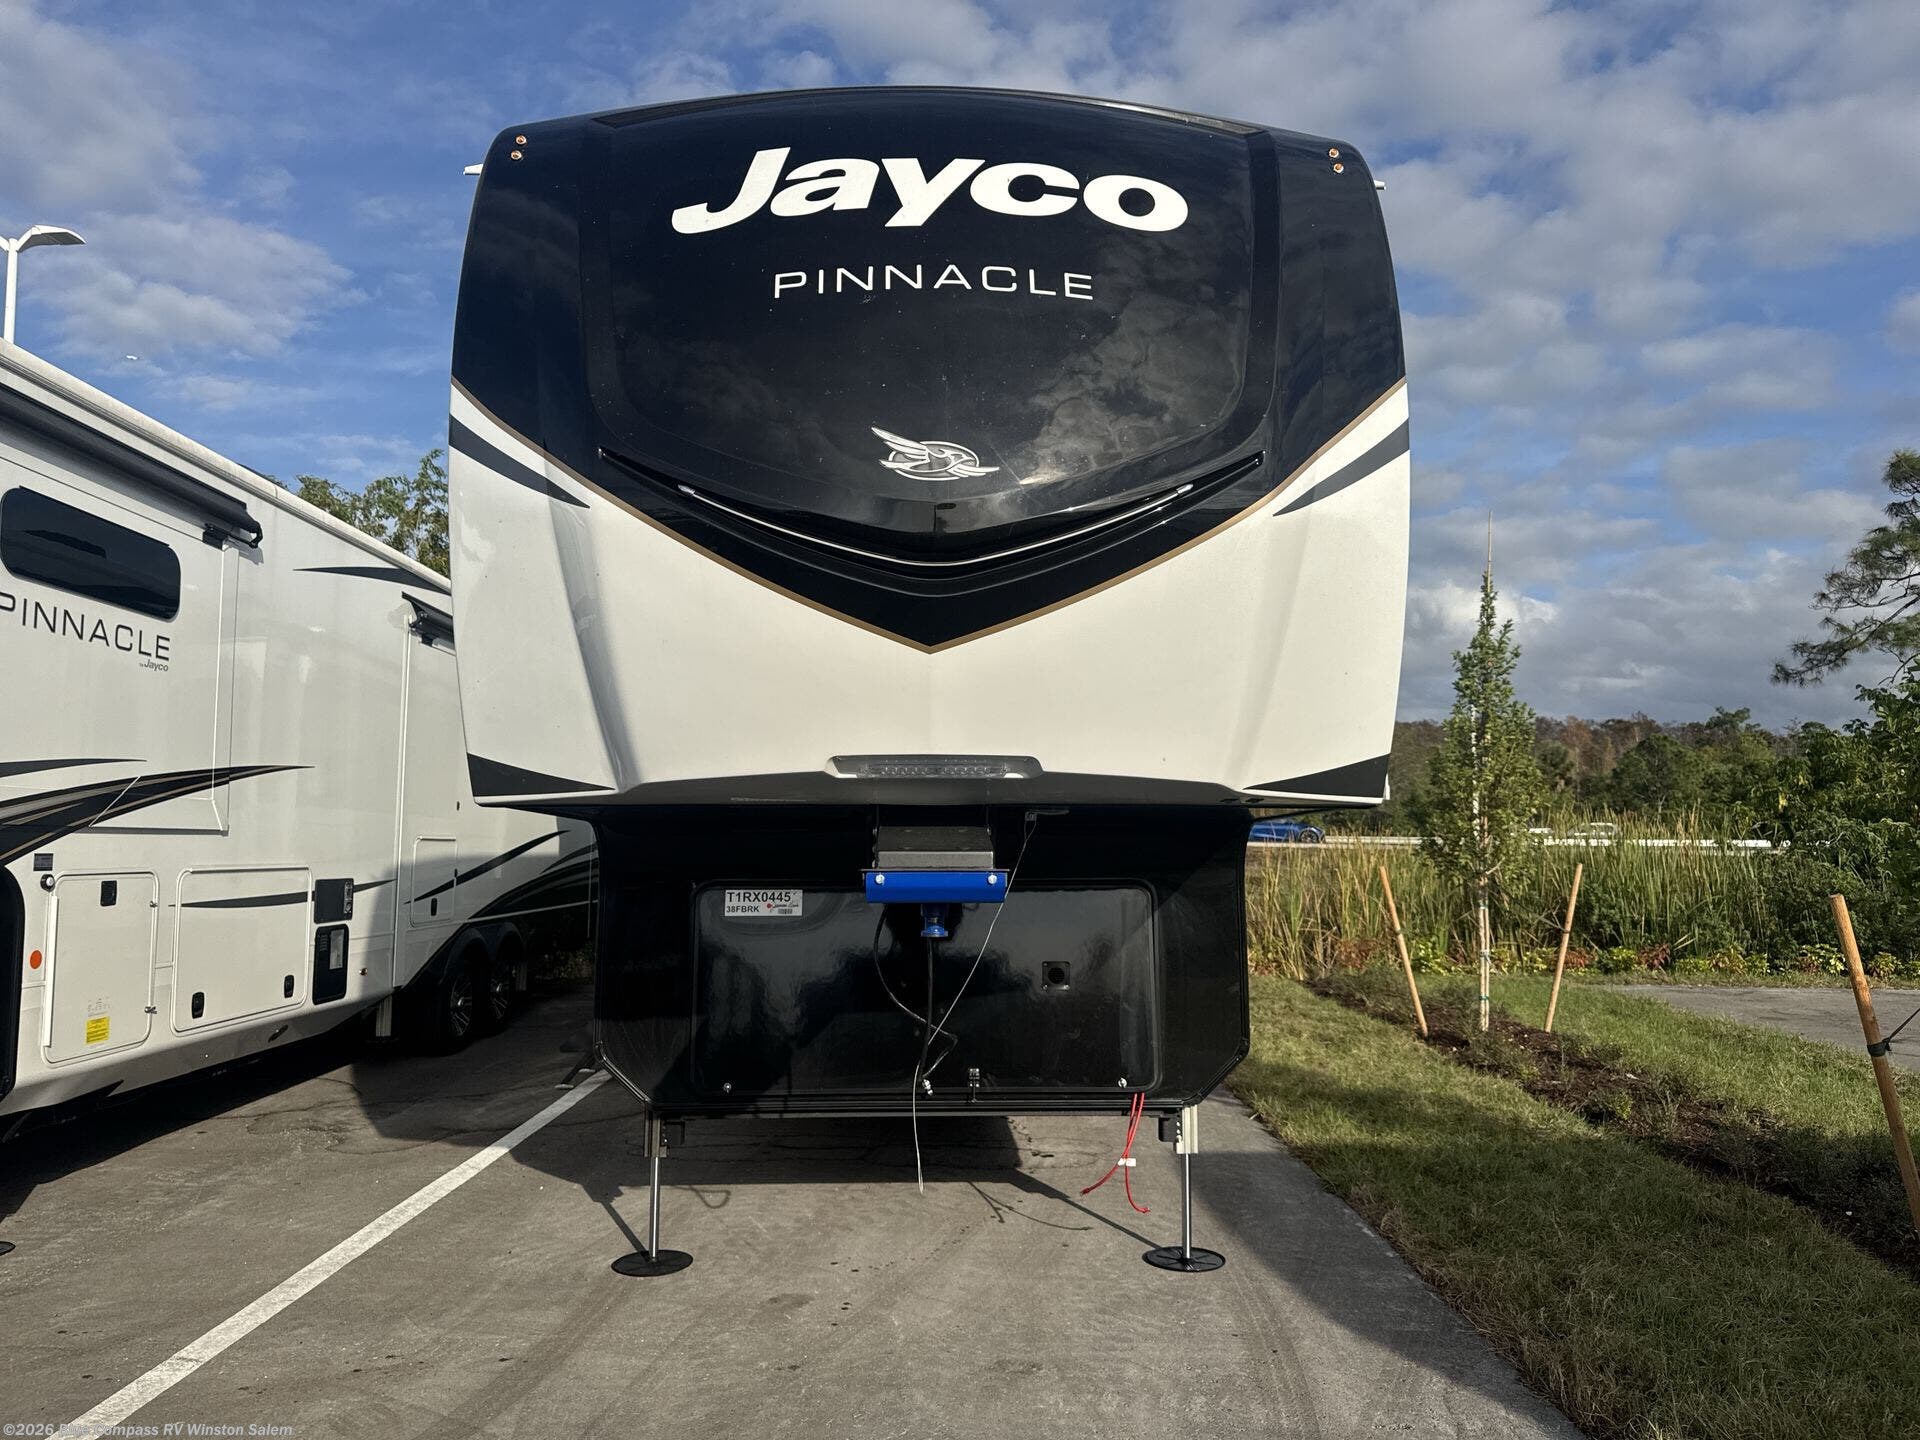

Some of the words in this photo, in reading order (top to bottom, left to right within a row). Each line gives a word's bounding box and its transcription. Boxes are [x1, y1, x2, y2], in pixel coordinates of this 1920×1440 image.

[671, 147, 1189, 235] Jayco
[774, 263, 1094, 301] PINNACLE
[144, 659, 169, 671] Jayco
[726, 891, 791, 902] T1RX0445
[726, 905, 760, 913] 38FBRK
